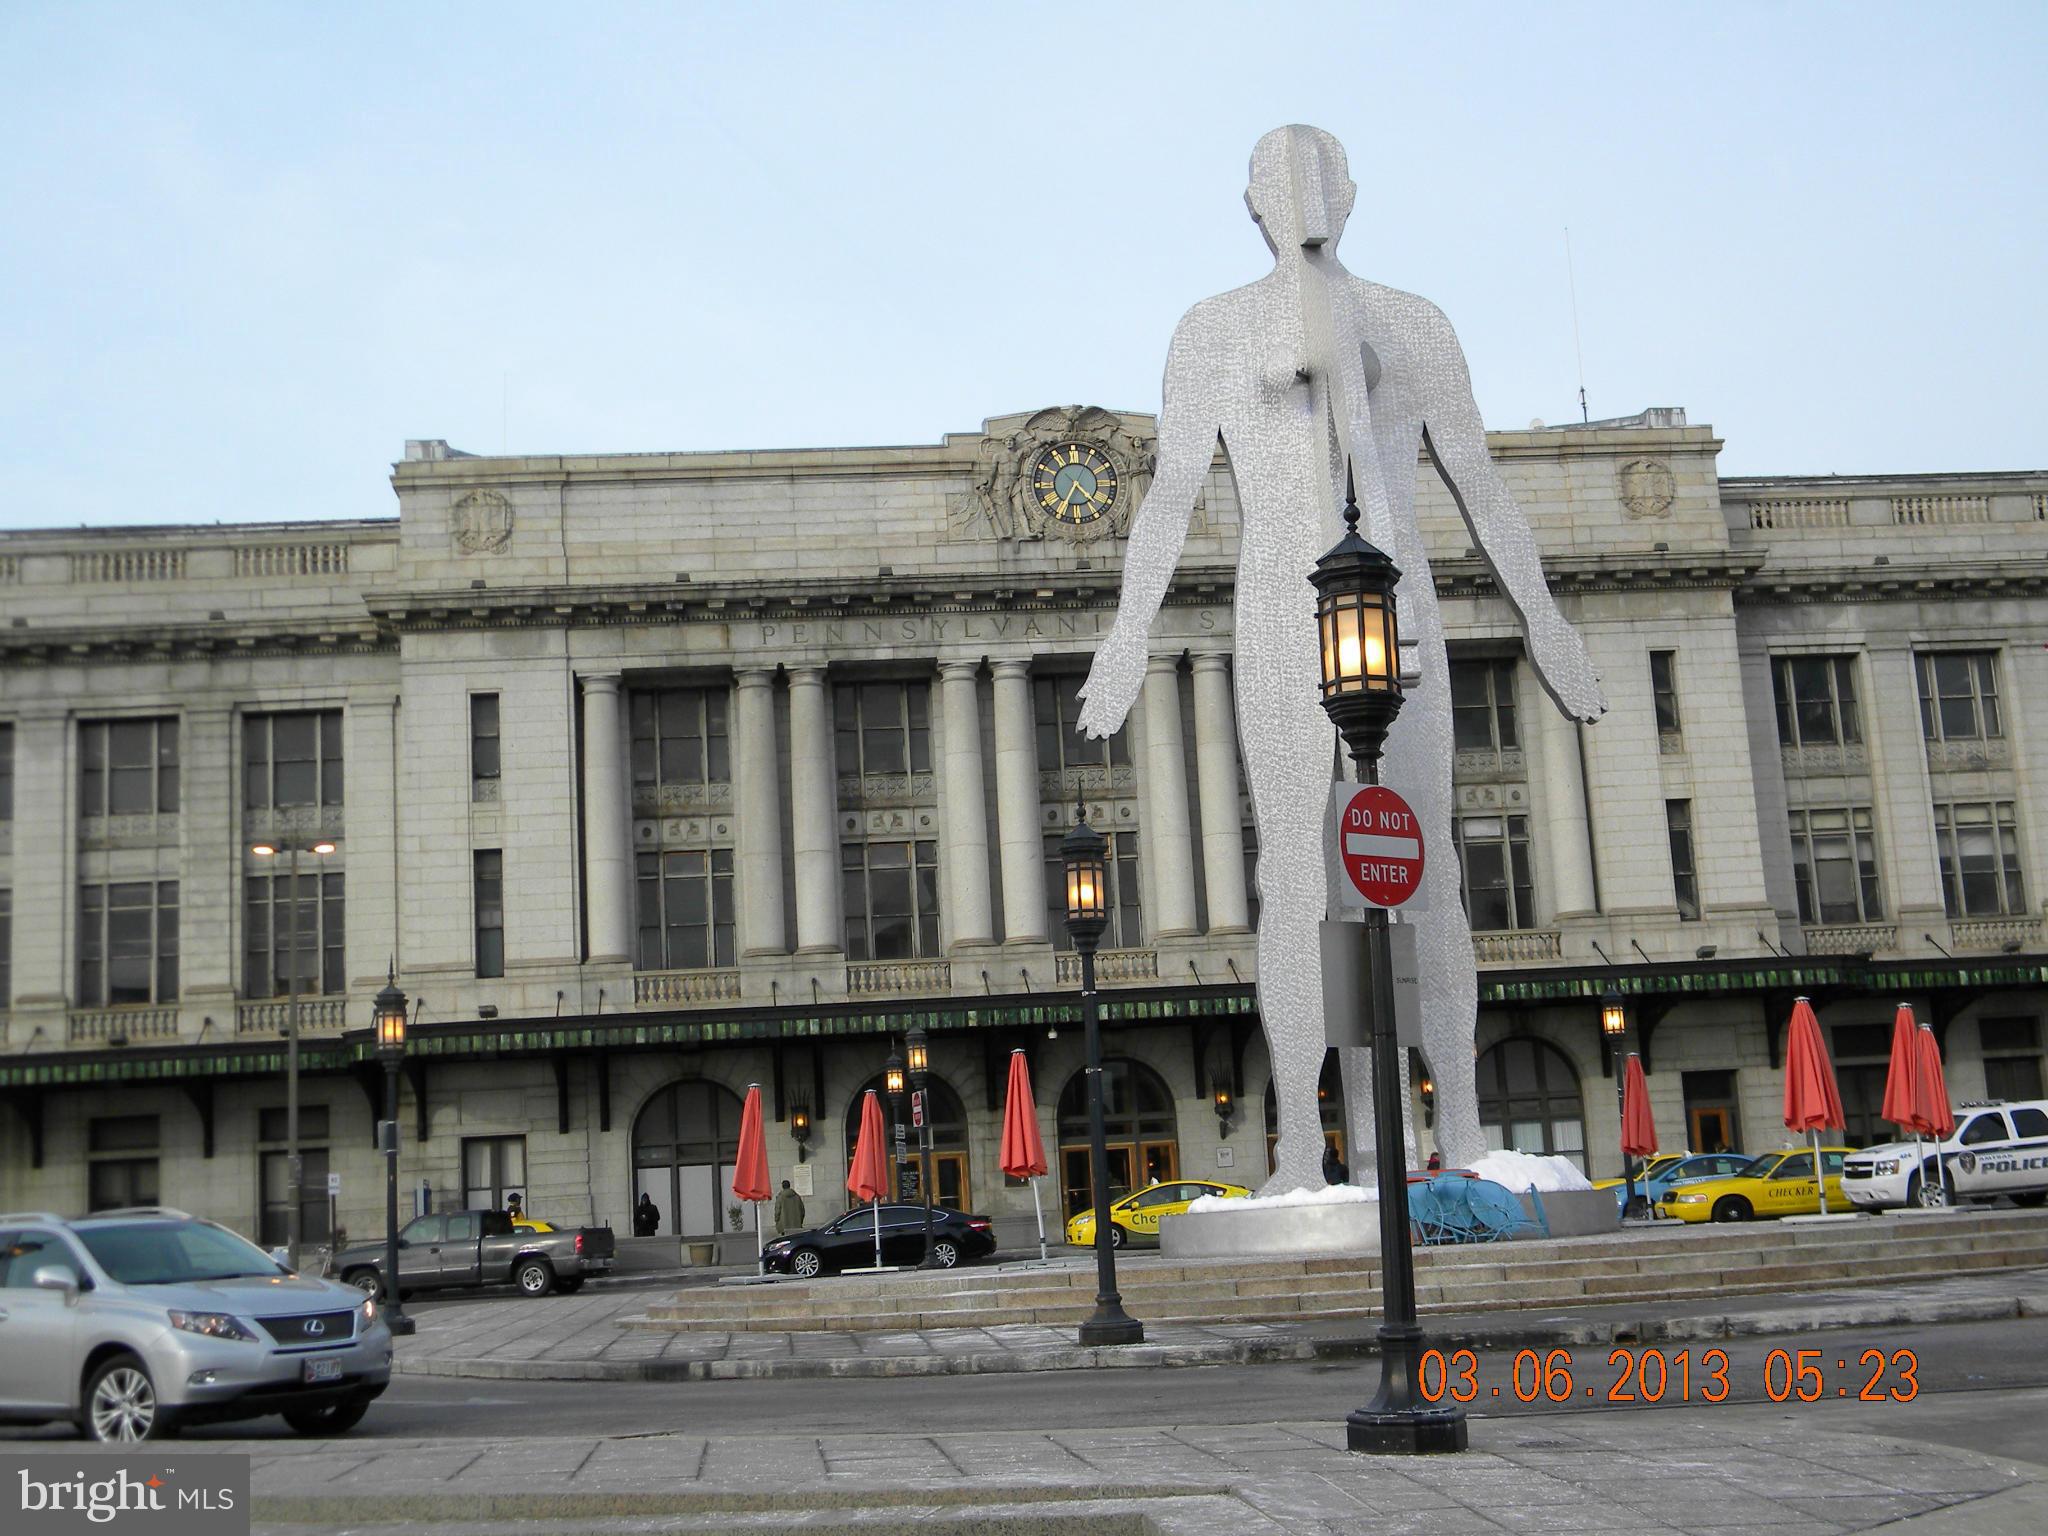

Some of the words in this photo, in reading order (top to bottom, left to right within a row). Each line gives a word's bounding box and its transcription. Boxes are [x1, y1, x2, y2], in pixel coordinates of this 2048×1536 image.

[761, 613, 1102, 645] PENNSYLVANI
[1351, 808, 1373, 828] DO
[1379, 811, 1410, 831] NOT
[1360, 862, 1409, 884] ENTER
[1768, 1186, 1814, 1199] CHECKER
